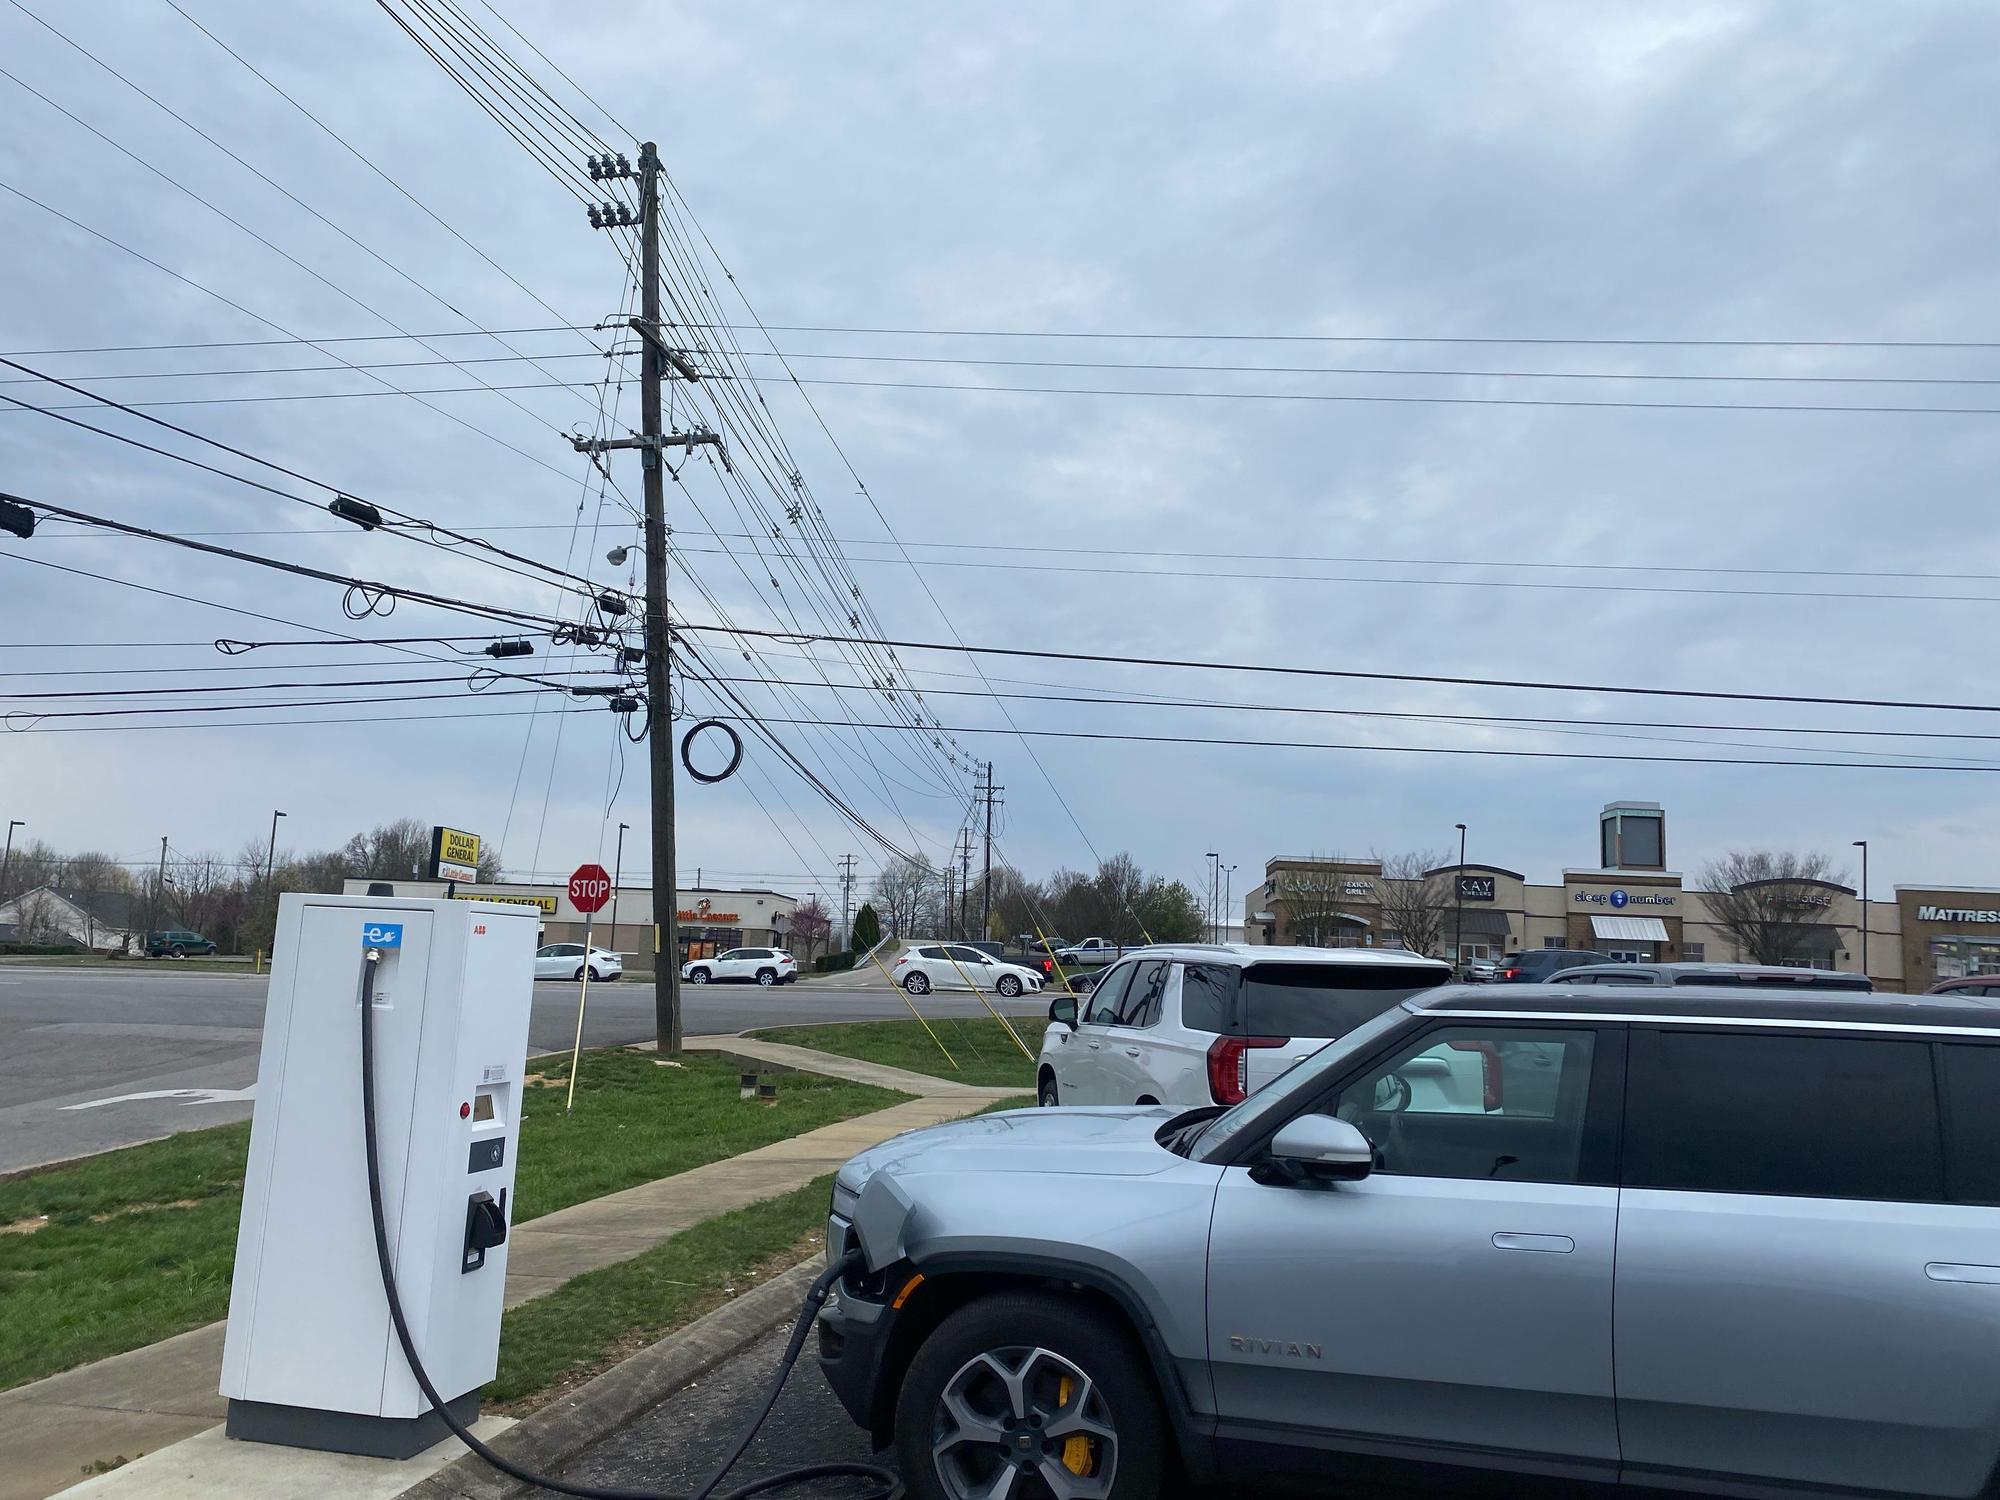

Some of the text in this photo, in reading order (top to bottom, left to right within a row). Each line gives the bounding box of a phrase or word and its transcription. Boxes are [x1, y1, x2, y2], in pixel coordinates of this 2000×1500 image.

[449, 834, 475, 849] DOLLAR
[446, 846, 475, 862] GENERAL
[571, 879, 609, 898] STOP
[1575, 891, 1677, 906] sleep number
[677, 909, 698, 921] ittle
[1917, 904, 2000, 923] MATTRES
[473, 925, 486, 935] ABB
[1230, 1336, 1322, 1359] RIVIAN
